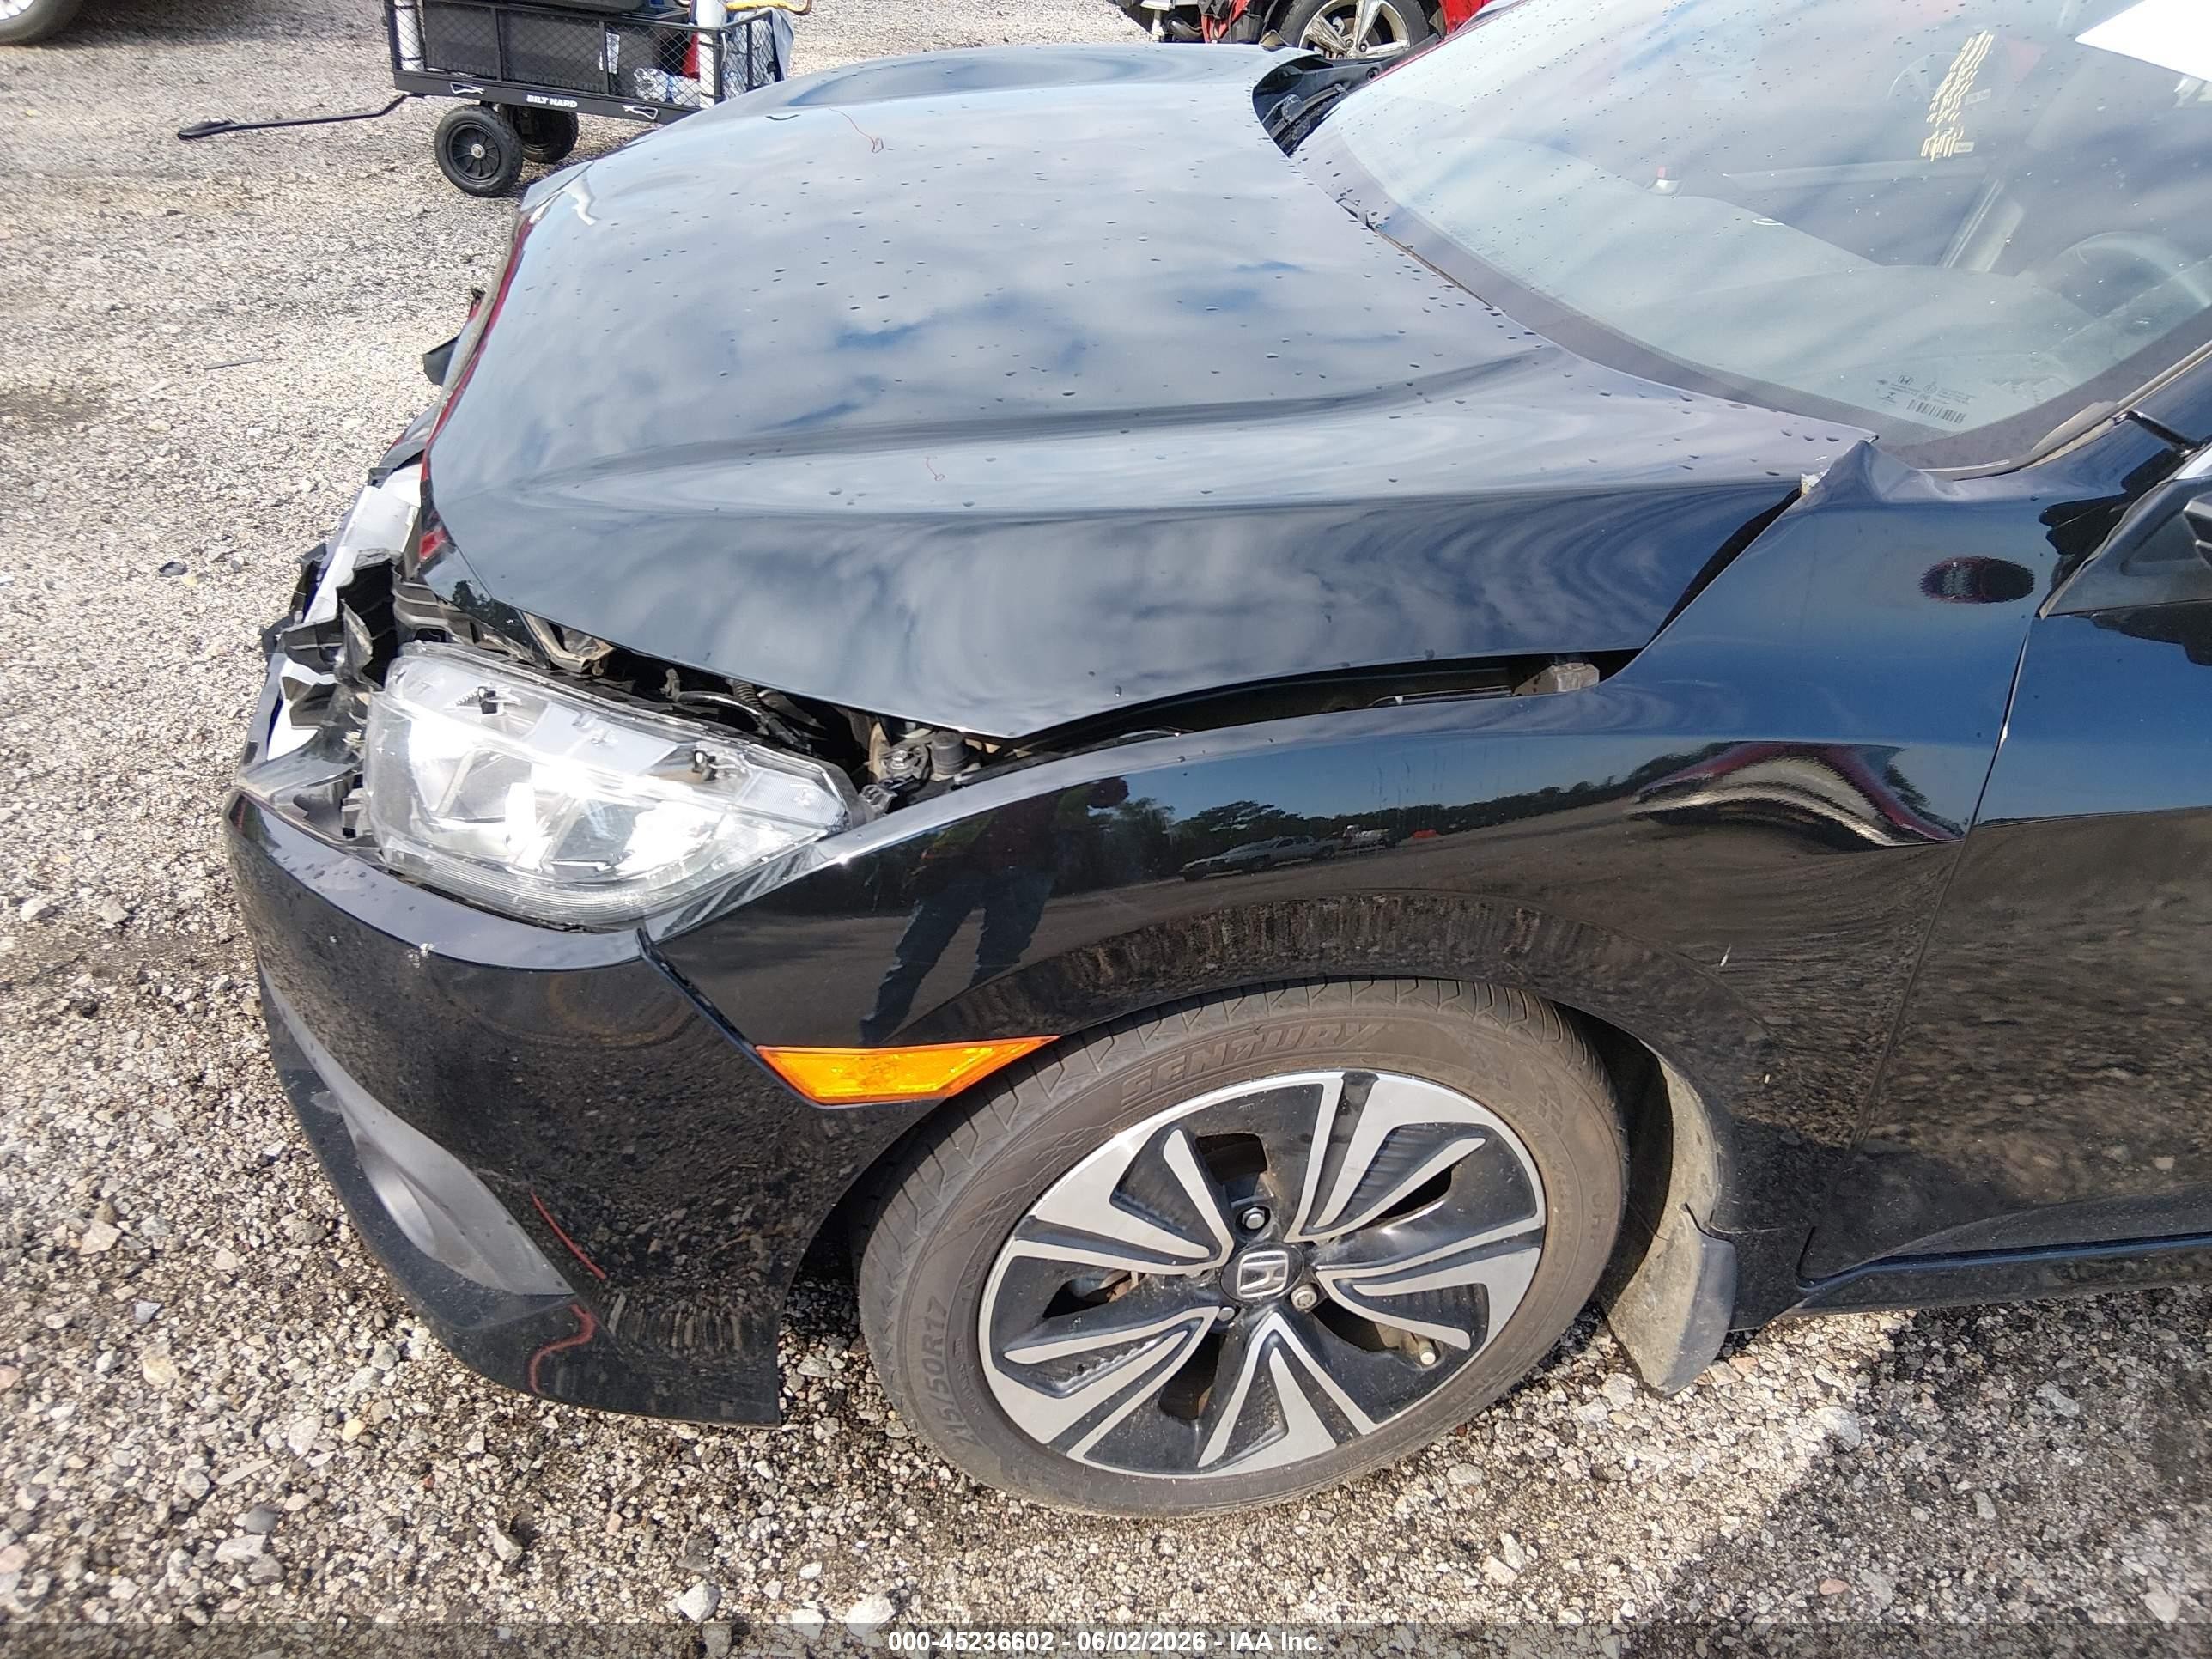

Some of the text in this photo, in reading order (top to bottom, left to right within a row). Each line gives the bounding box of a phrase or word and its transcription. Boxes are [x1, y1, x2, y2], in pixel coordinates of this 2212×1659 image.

[526, 94, 578, 108] BILT HARD
[1121, 1023, 1386, 1103] SENTURY
[921, 1295, 982, 1446] 215/50R17
